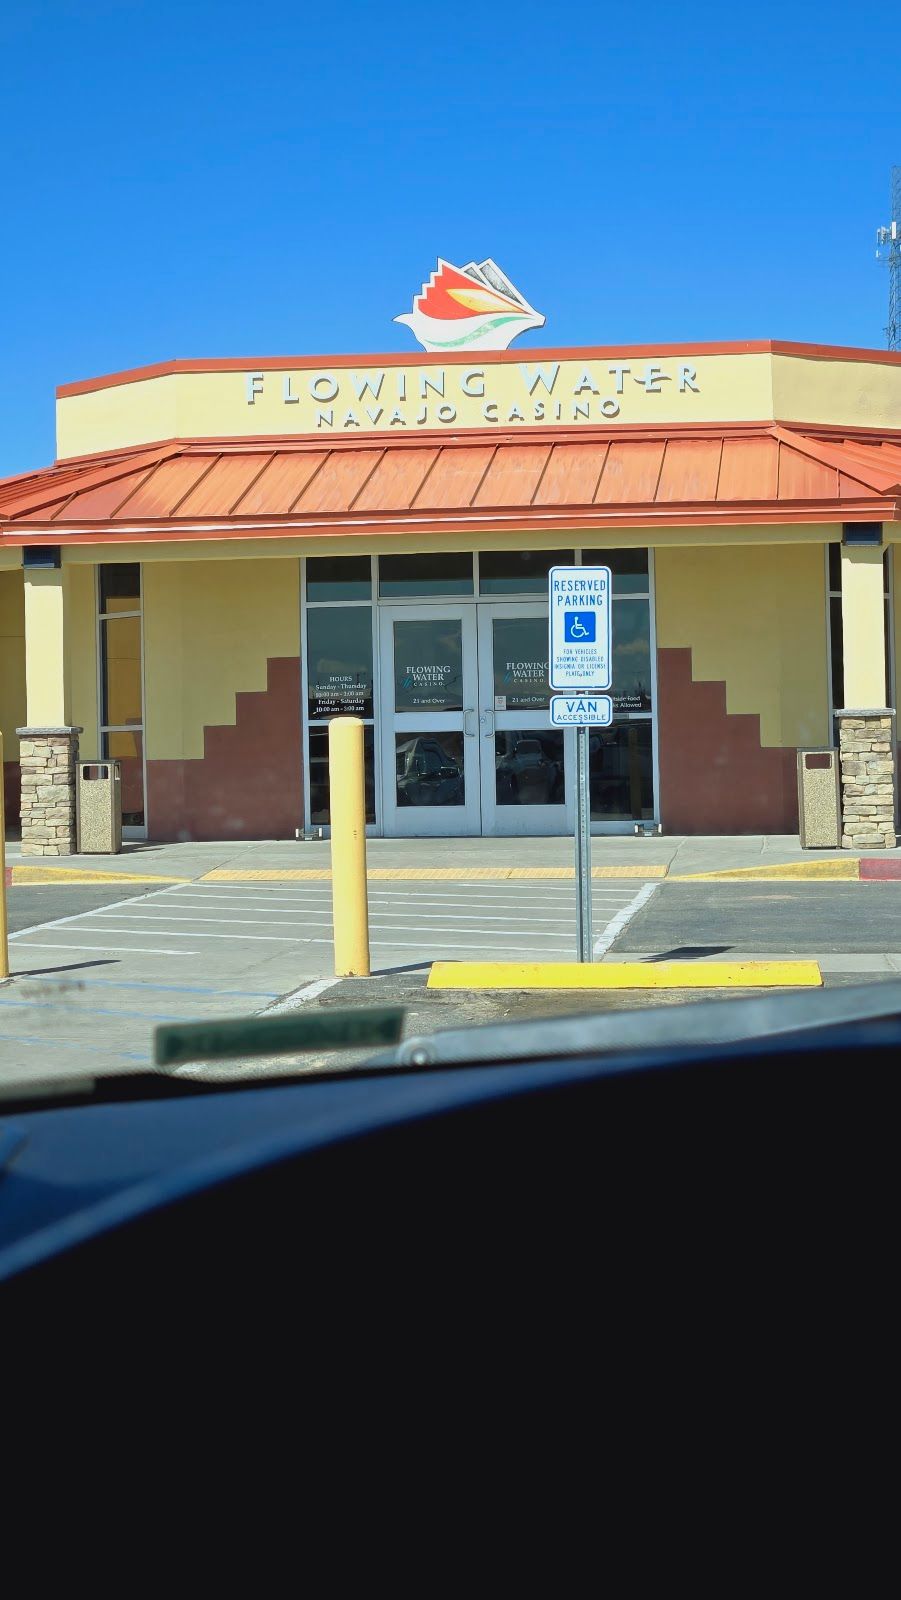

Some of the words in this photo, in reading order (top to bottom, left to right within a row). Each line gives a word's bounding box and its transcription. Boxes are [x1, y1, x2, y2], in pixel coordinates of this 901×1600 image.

[246, 368, 485, 405] FLOWING
[519, 361, 701, 397] WATER
[316, 401, 457, 428] NAVAJO
[483, 396, 621, 423] CASINO
[554, 580, 606, 592] RESERVED
[557, 595, 603, 607] PARKING
[406, 665, 451, 674] FLOWING
[512, 669, 545, 678] WATER
[412, 673, 445, 681] WATER
[565, 701, 598, 713] VAN
